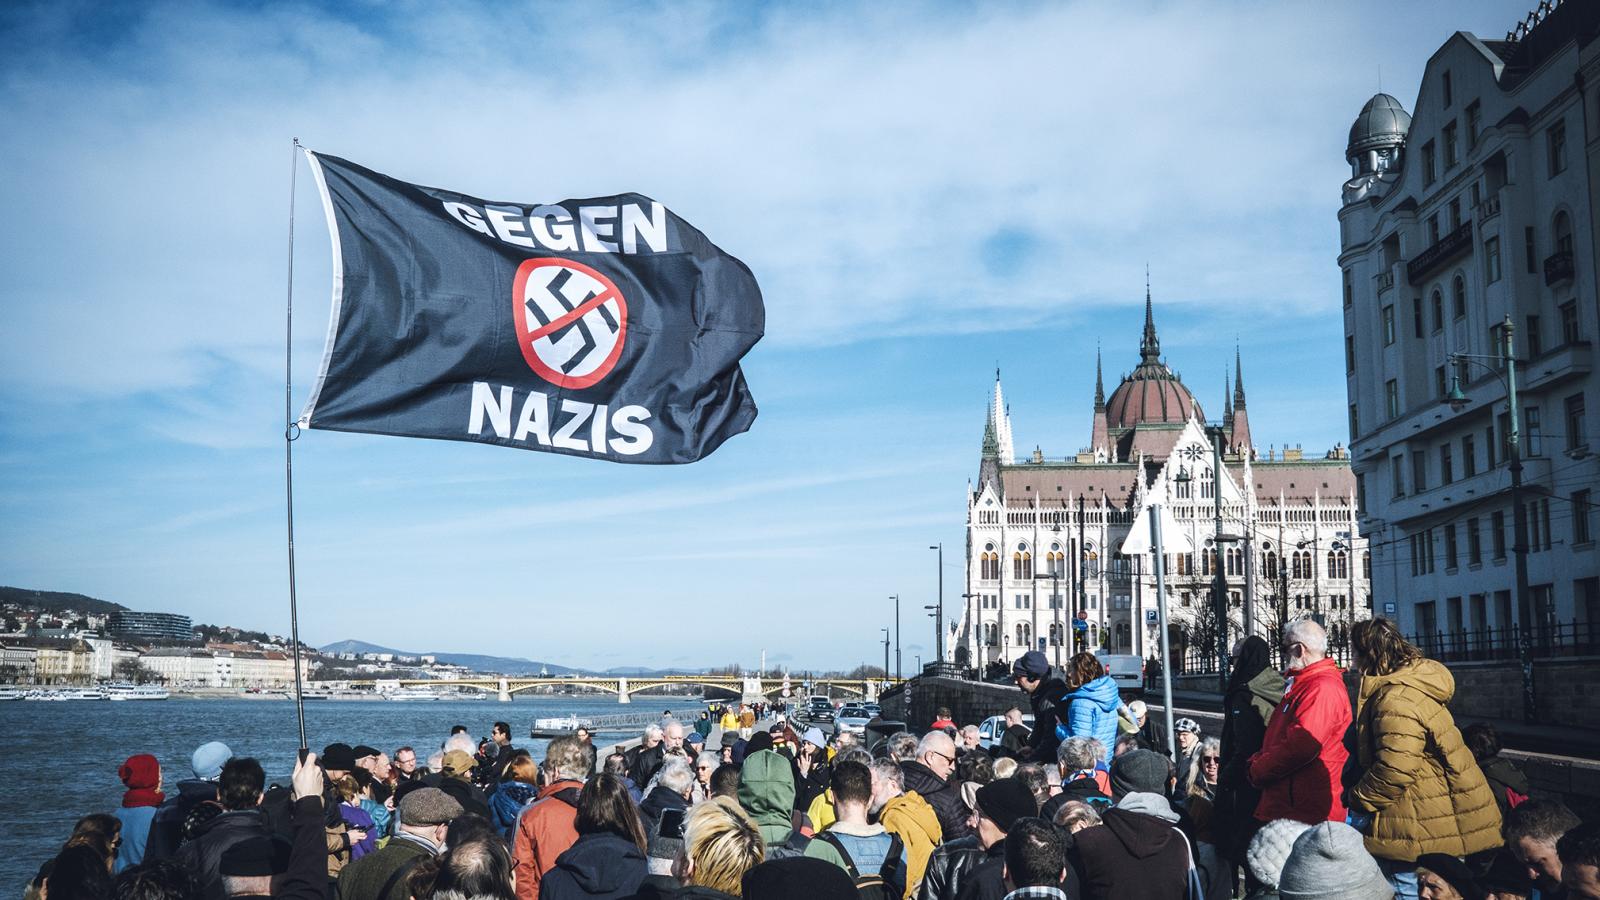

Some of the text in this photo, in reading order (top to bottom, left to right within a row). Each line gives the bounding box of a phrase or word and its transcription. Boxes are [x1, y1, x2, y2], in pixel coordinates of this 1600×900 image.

[443, 201, 667, 254] GEGEN
[468, 381, 654, 455] NAZIS
[1149, 611, 1155, 619] P
